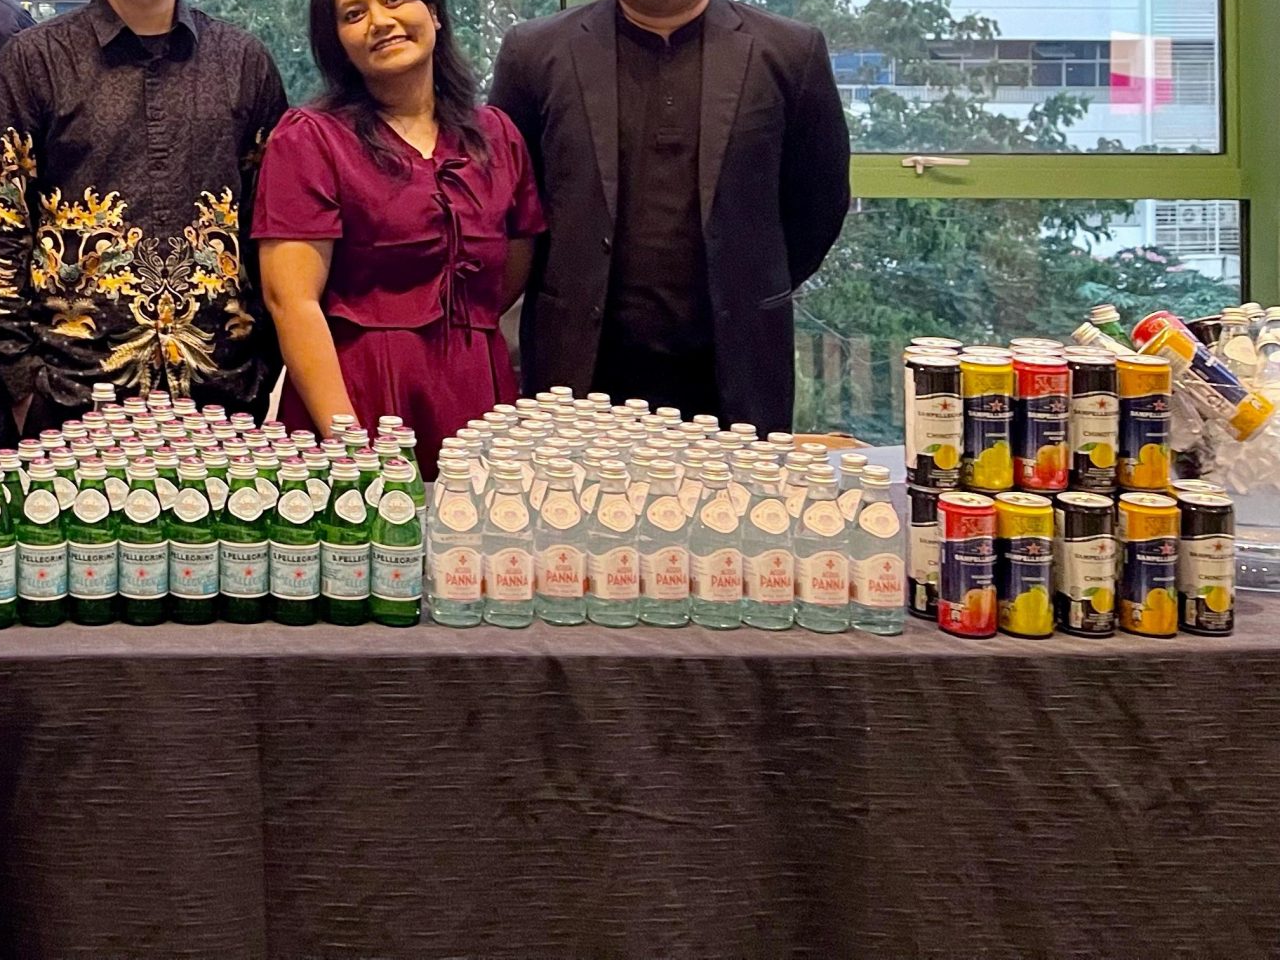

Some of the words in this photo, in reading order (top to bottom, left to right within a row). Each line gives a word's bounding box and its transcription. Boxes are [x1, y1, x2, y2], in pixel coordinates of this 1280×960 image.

[446, 573, 477, 585] PANNA
[496, 573, 528, 586] PANNA
[545, 570, 578, 583] PANNA
